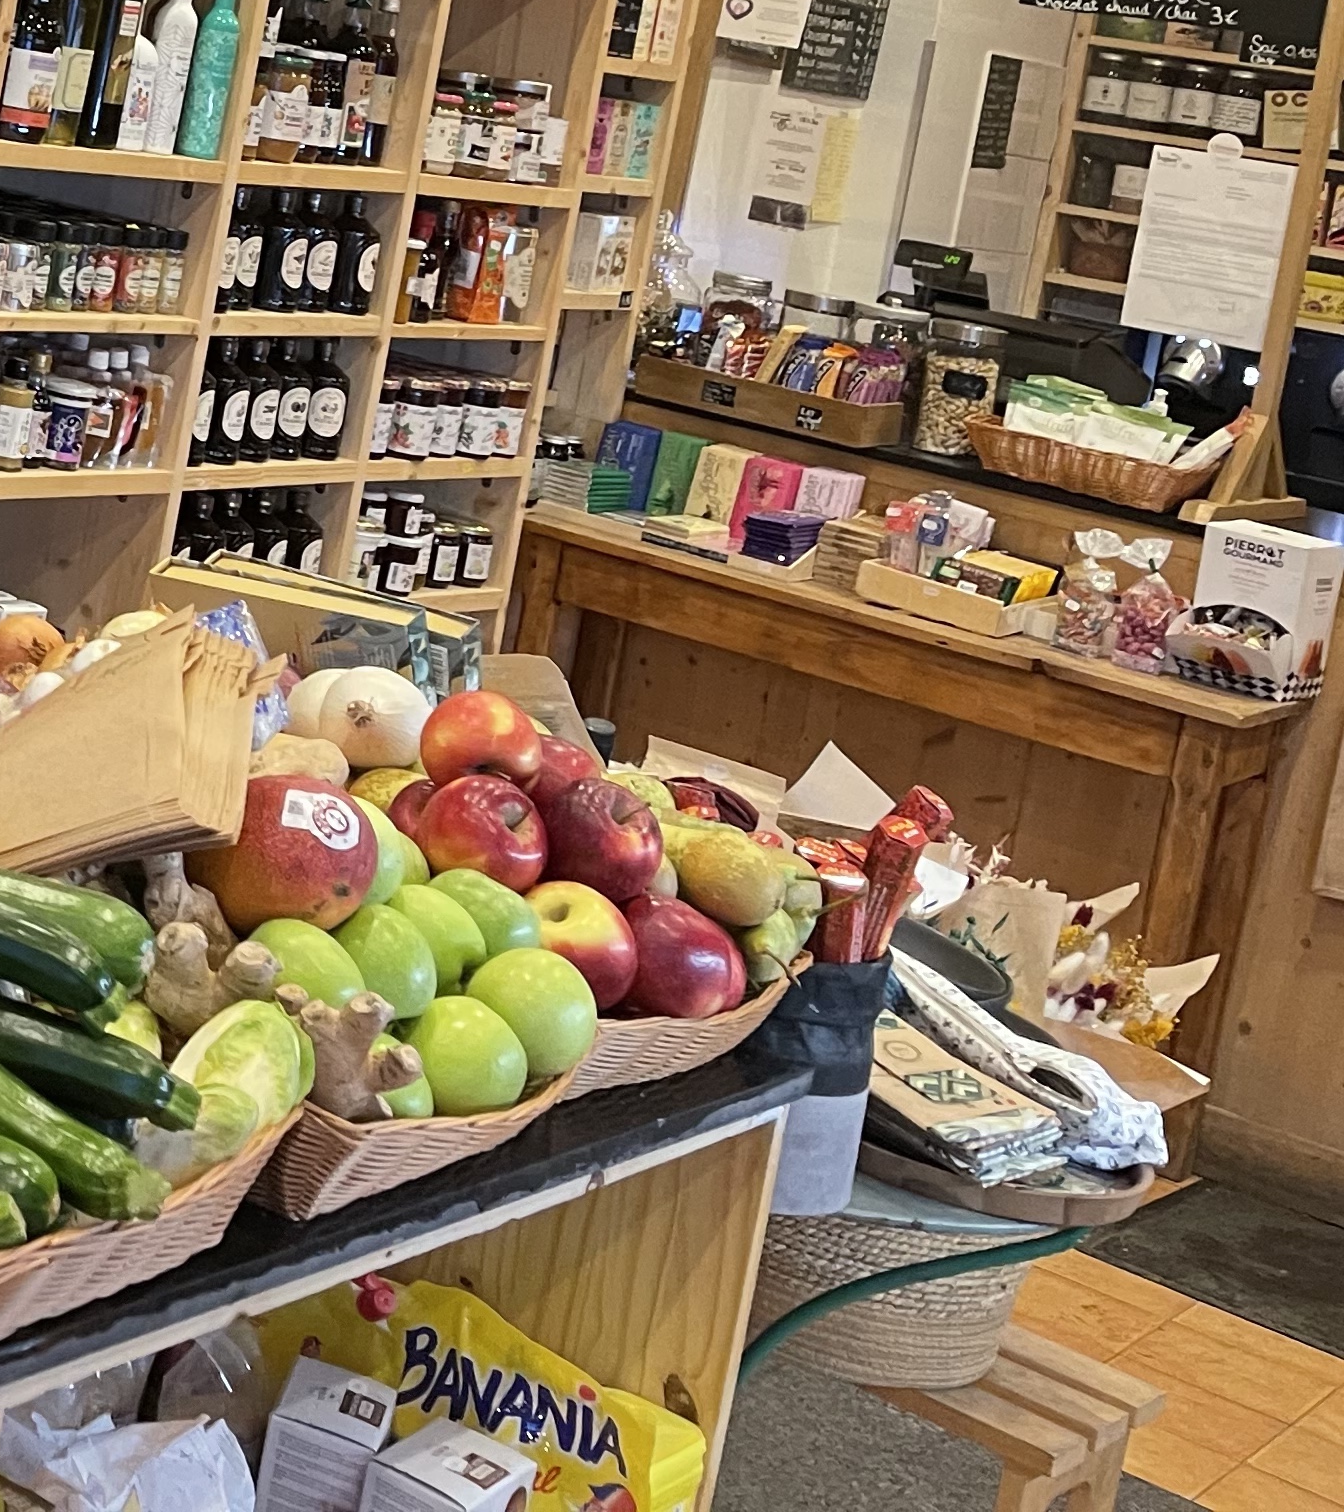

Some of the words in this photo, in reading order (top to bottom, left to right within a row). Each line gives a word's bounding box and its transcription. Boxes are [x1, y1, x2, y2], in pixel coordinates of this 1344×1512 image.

[1210, 6, 1239, 26] 3€
[1249, 34, 1280, 56] Sac
[395, 1326, 628, 1480] BANANIA
